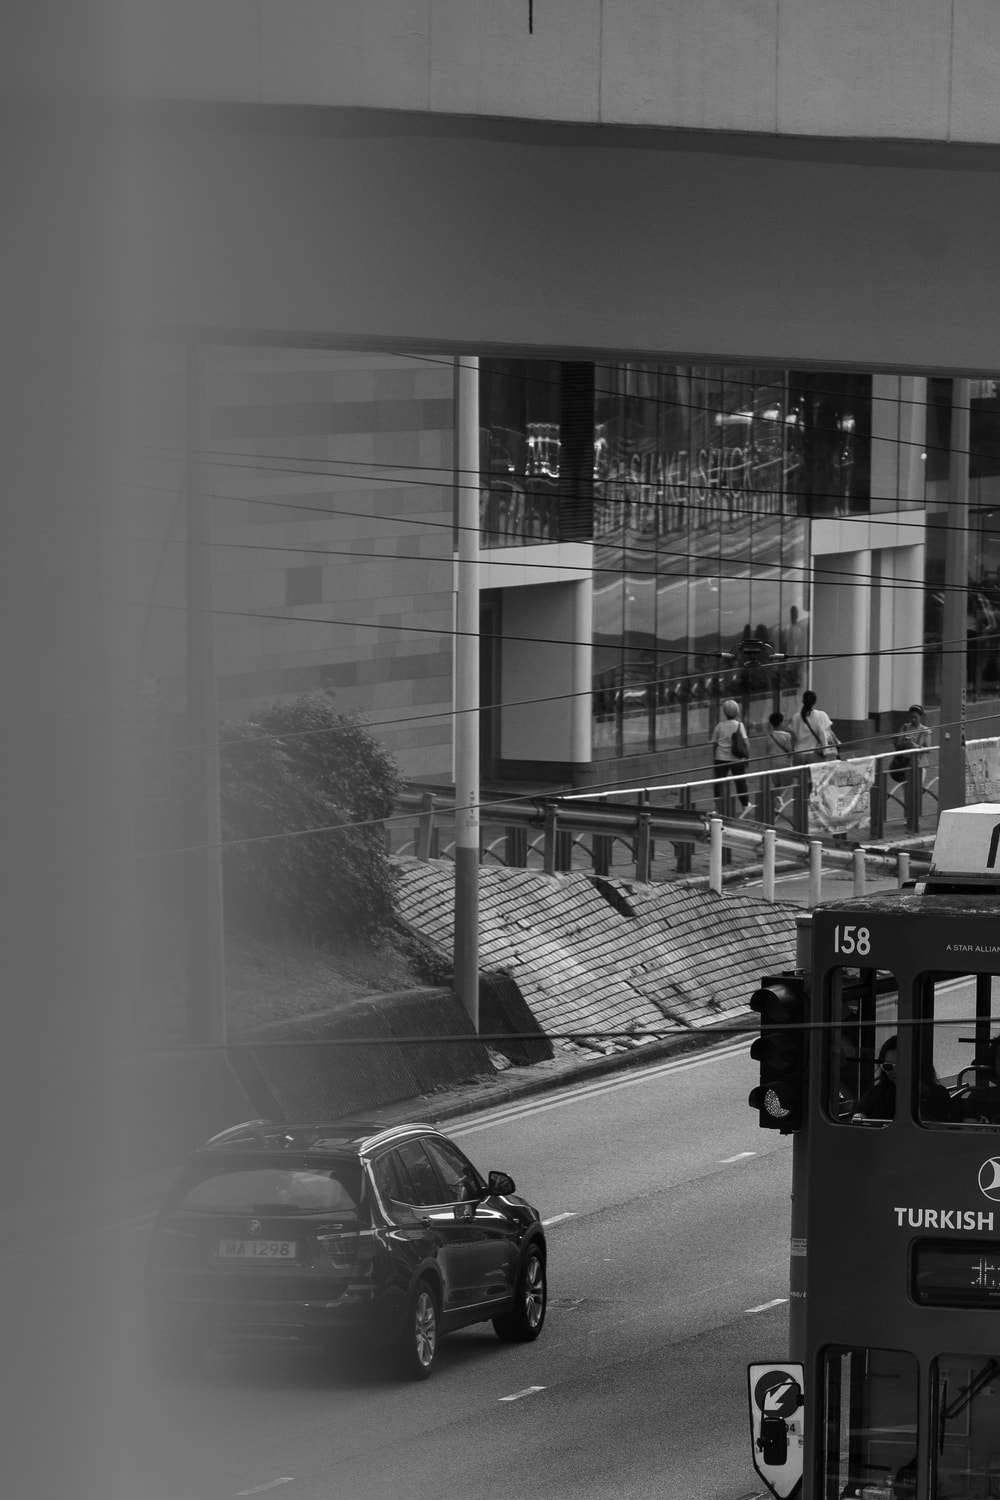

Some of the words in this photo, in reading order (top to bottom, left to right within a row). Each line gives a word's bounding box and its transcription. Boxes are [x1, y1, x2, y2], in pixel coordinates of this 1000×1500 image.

[834, 925, 871, 956] 158
[946, 944, 952, 952] A
[953, 944, 973, 952] STAR
[894, 1207, 994, 1231] TURKISH
